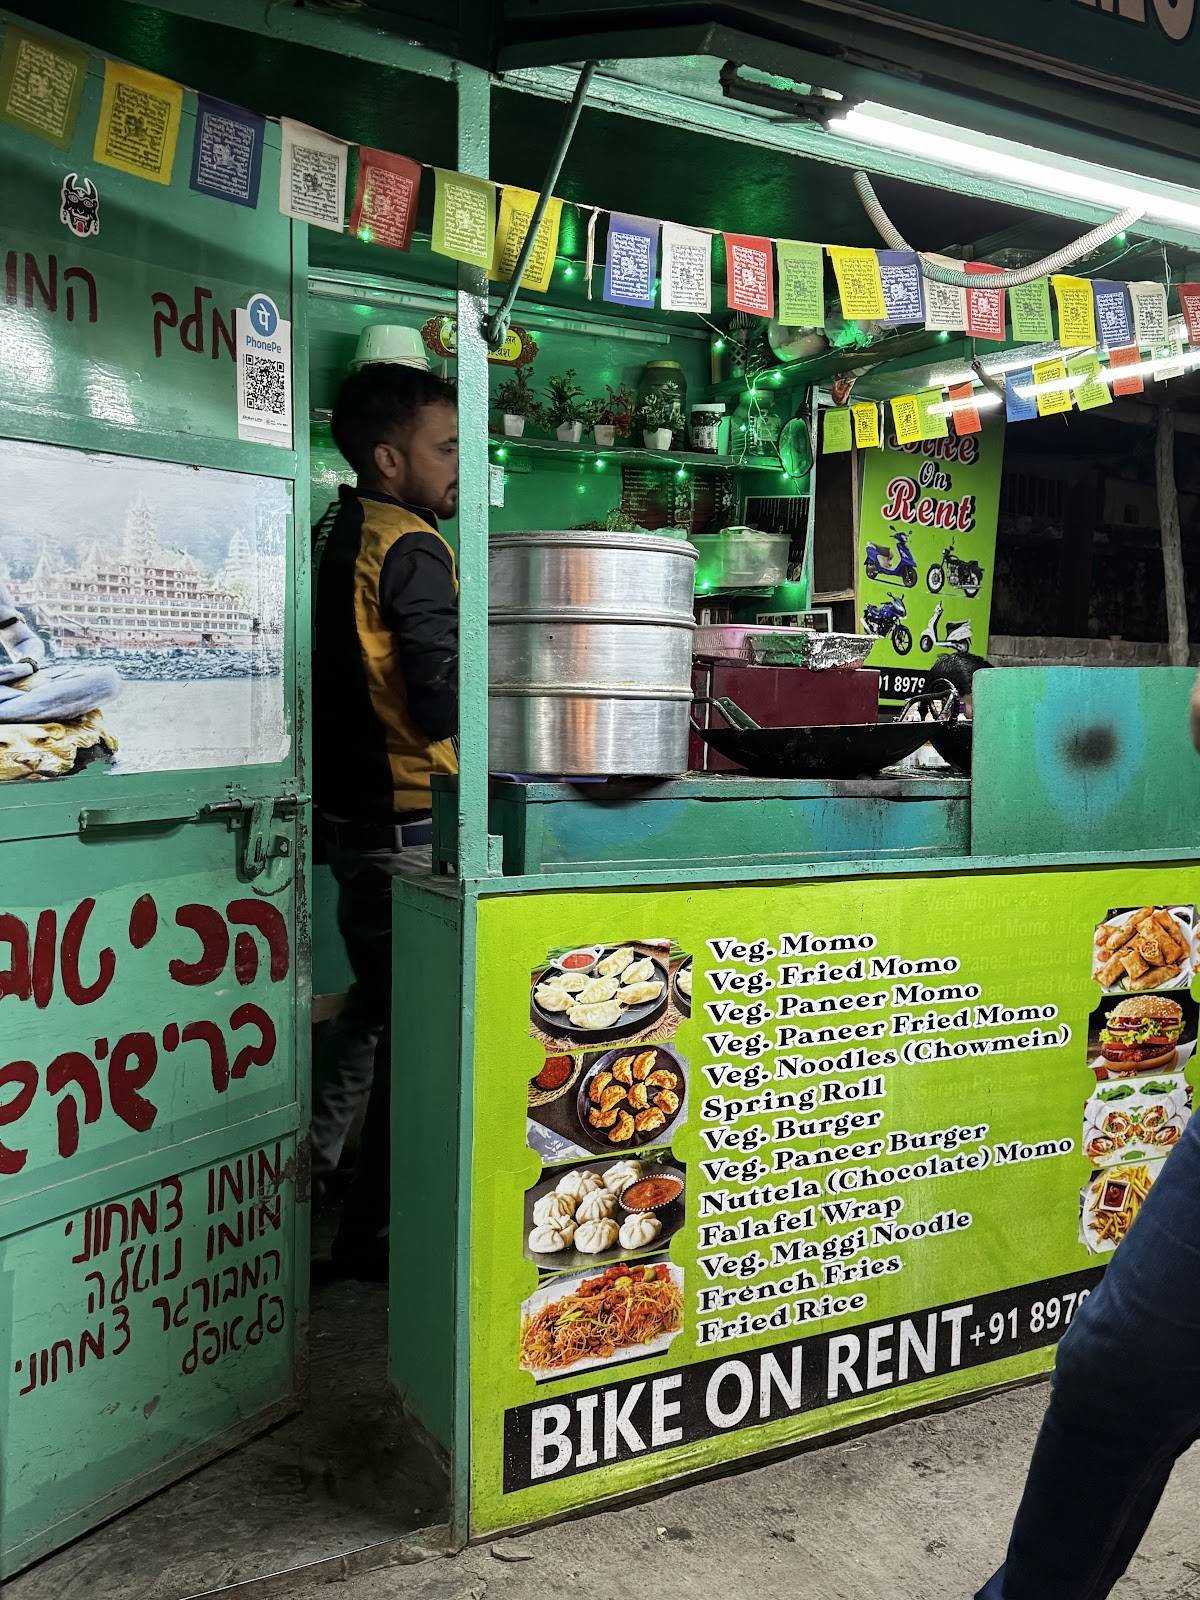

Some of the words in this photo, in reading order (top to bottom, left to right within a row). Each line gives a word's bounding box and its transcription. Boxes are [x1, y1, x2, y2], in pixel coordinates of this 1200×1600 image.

[151, 286, 237, 362] מלך
[246, 335, 283, 354] PhonePe
[881, 476, 976, 532] Rent
[919, 460, 951, 491] On
[129, 893, 289, 986] הכי
[709, 940, 774, 963] Veg.
[781, 934, 874, 955] Momo
[709, 971, 772, 994] Veg.
[782, 961, 863, 985] Fried
[871, 958, 958, 976] Momo
[709, 1003, 771, 1025] Veg.
[780, 993, 887, 1016] Paneer
[896, 985, 979, 1003] Momo
[706, 1034, 770, 1057] Veg.
[778, 1023, 885, 1047] Paneer
[893, 1009, 969, 1034] Fried
[977, 1006, 1056, 1024] Momo
[706, 1065, 769, 1088] Veg.
[776, 1049, 896, 1078] Noodles
[903, 1025, 1070, 1063] (Chowmein)
[703, 1089, 815, 1122] Spring
[822, 1077, 883, 1102] Roll
[704, 1127, 767, 1150] Veg.
[775, 1112, 881, 1141] Burger
[704, 1160, 767, 1183] Veg.
[775, 1142, 882, 1170] Paneer
[889, 1126, 987, 1152] Burger
[207, 1141, 282, 1215] מומו
[702, 1181, 820, 1214] Nuttela
[827, 1149, 990, 1194] (Chocolate)
[995, 1140, 1072, 1164] Momo
[64, 1173, 184, 1265] צמחוני
[206, 1195, 282, 1263] מומו
[701, 1209, 813, 1247] Falafel
[819, 1199, 901, 1223] Wrap
[701, 1253, 765, 1277] Veg.
[773, 1232, 867, 1265] Maggi
[873, 1213, 970, 1244] Noodle
[84, 1236, 182, 1314] נוטלה
[152, 1249, 282, 1331] המבורגר
[700, 1273, 816, 1311] French
[825, 1259, 900, 1285] Fries
[181, 1292, 285, 1375] פלאפל
[699, 1307, 788, 1344] Fried
[796, 1296, 864, 1322] Rice
[14, 1304, 132, 1397] צמחוני
[530, 1373, 685, 1482] BIKE
[703, 1344, 802, 1429] ON
[827, 1304, 975, 1400] RENT
[969, 1309, 1020, 1348] +91
